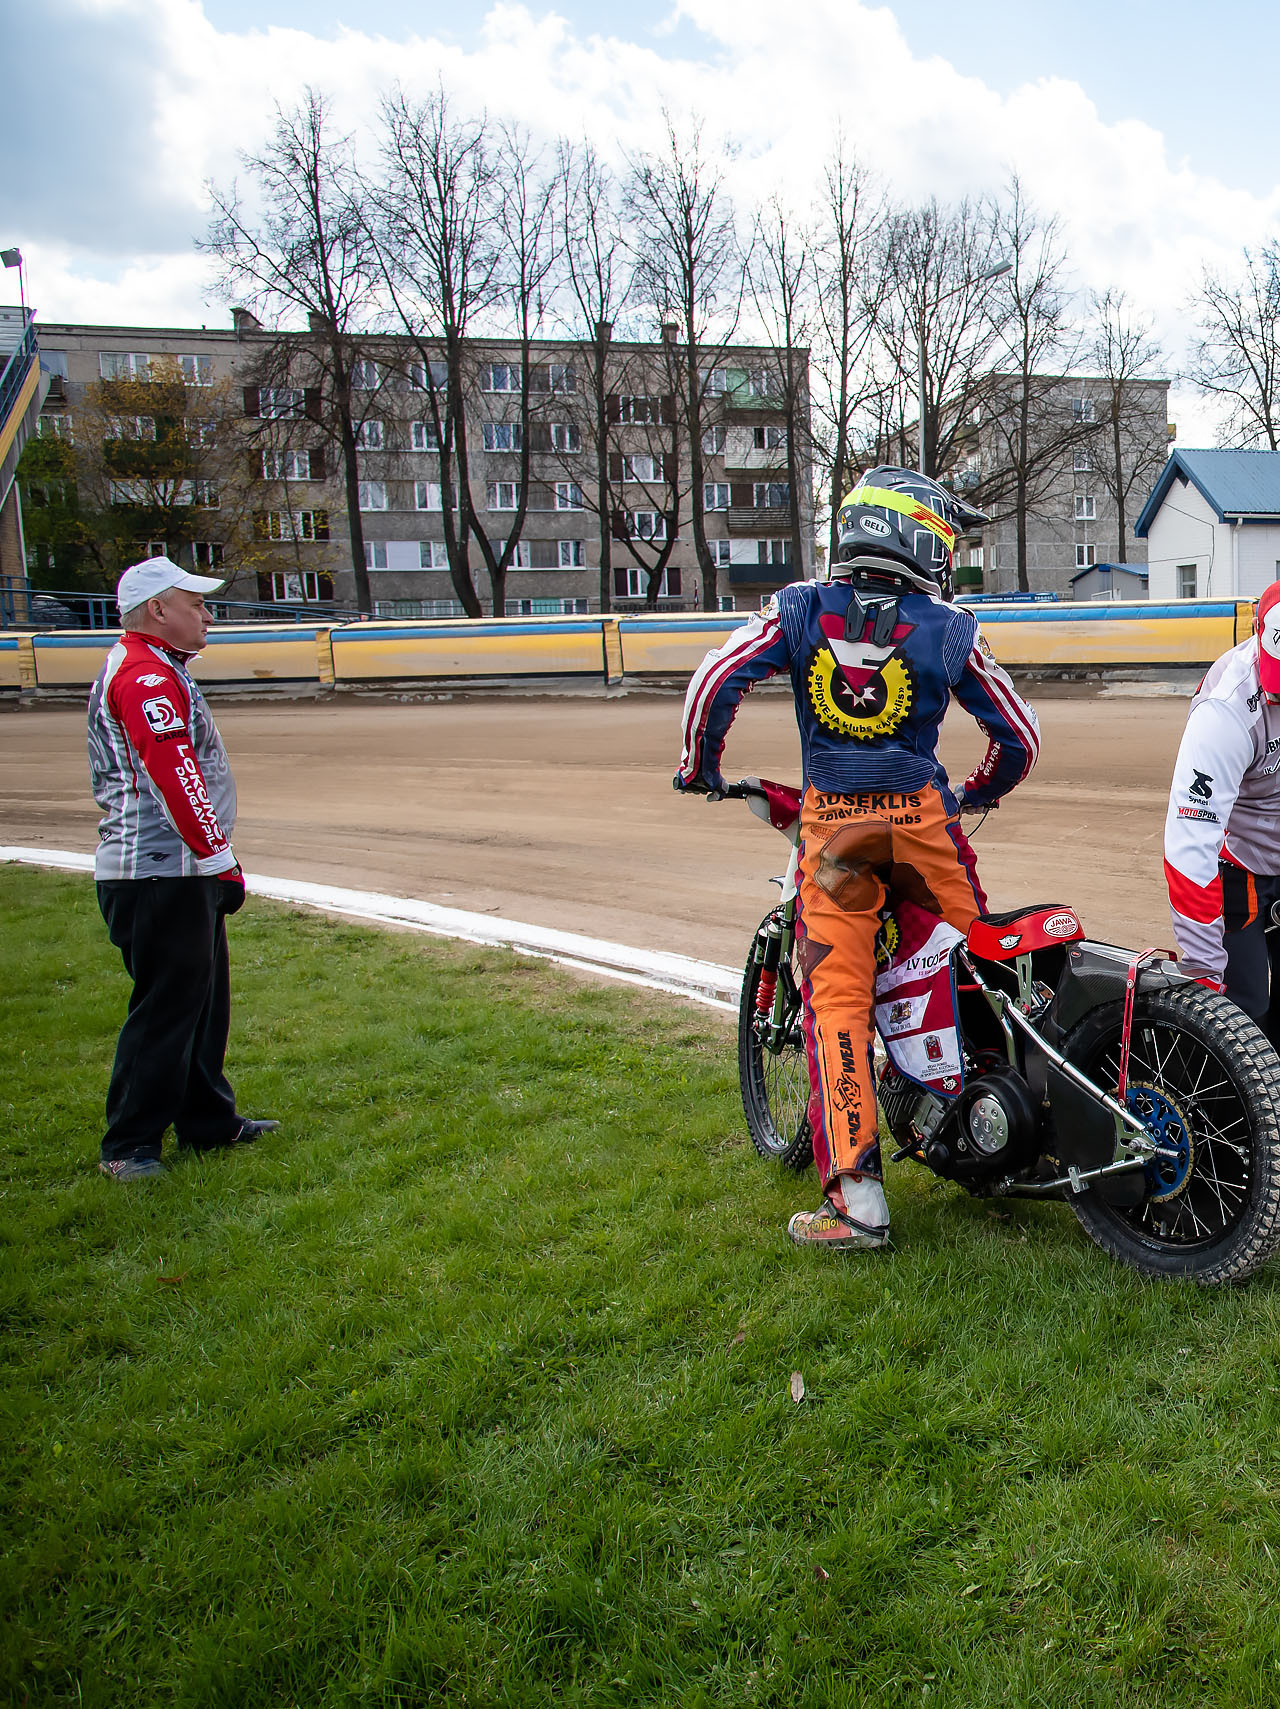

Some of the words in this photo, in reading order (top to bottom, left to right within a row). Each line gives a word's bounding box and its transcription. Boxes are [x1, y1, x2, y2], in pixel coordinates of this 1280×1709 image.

[863, 519, 887, 534] BELL
[842, 721, 873, 733] klubs
[815, 793, 922, 810] AUSEKLIS
[175, 766, 221, 854] DAUGAVPILS
[879, 813, 922, 826] lubs
[1050, 917, 1073, 928] JAWA
[906, 957, 920, 971] LV
[837, 1029, 856, 1074] WEAR
